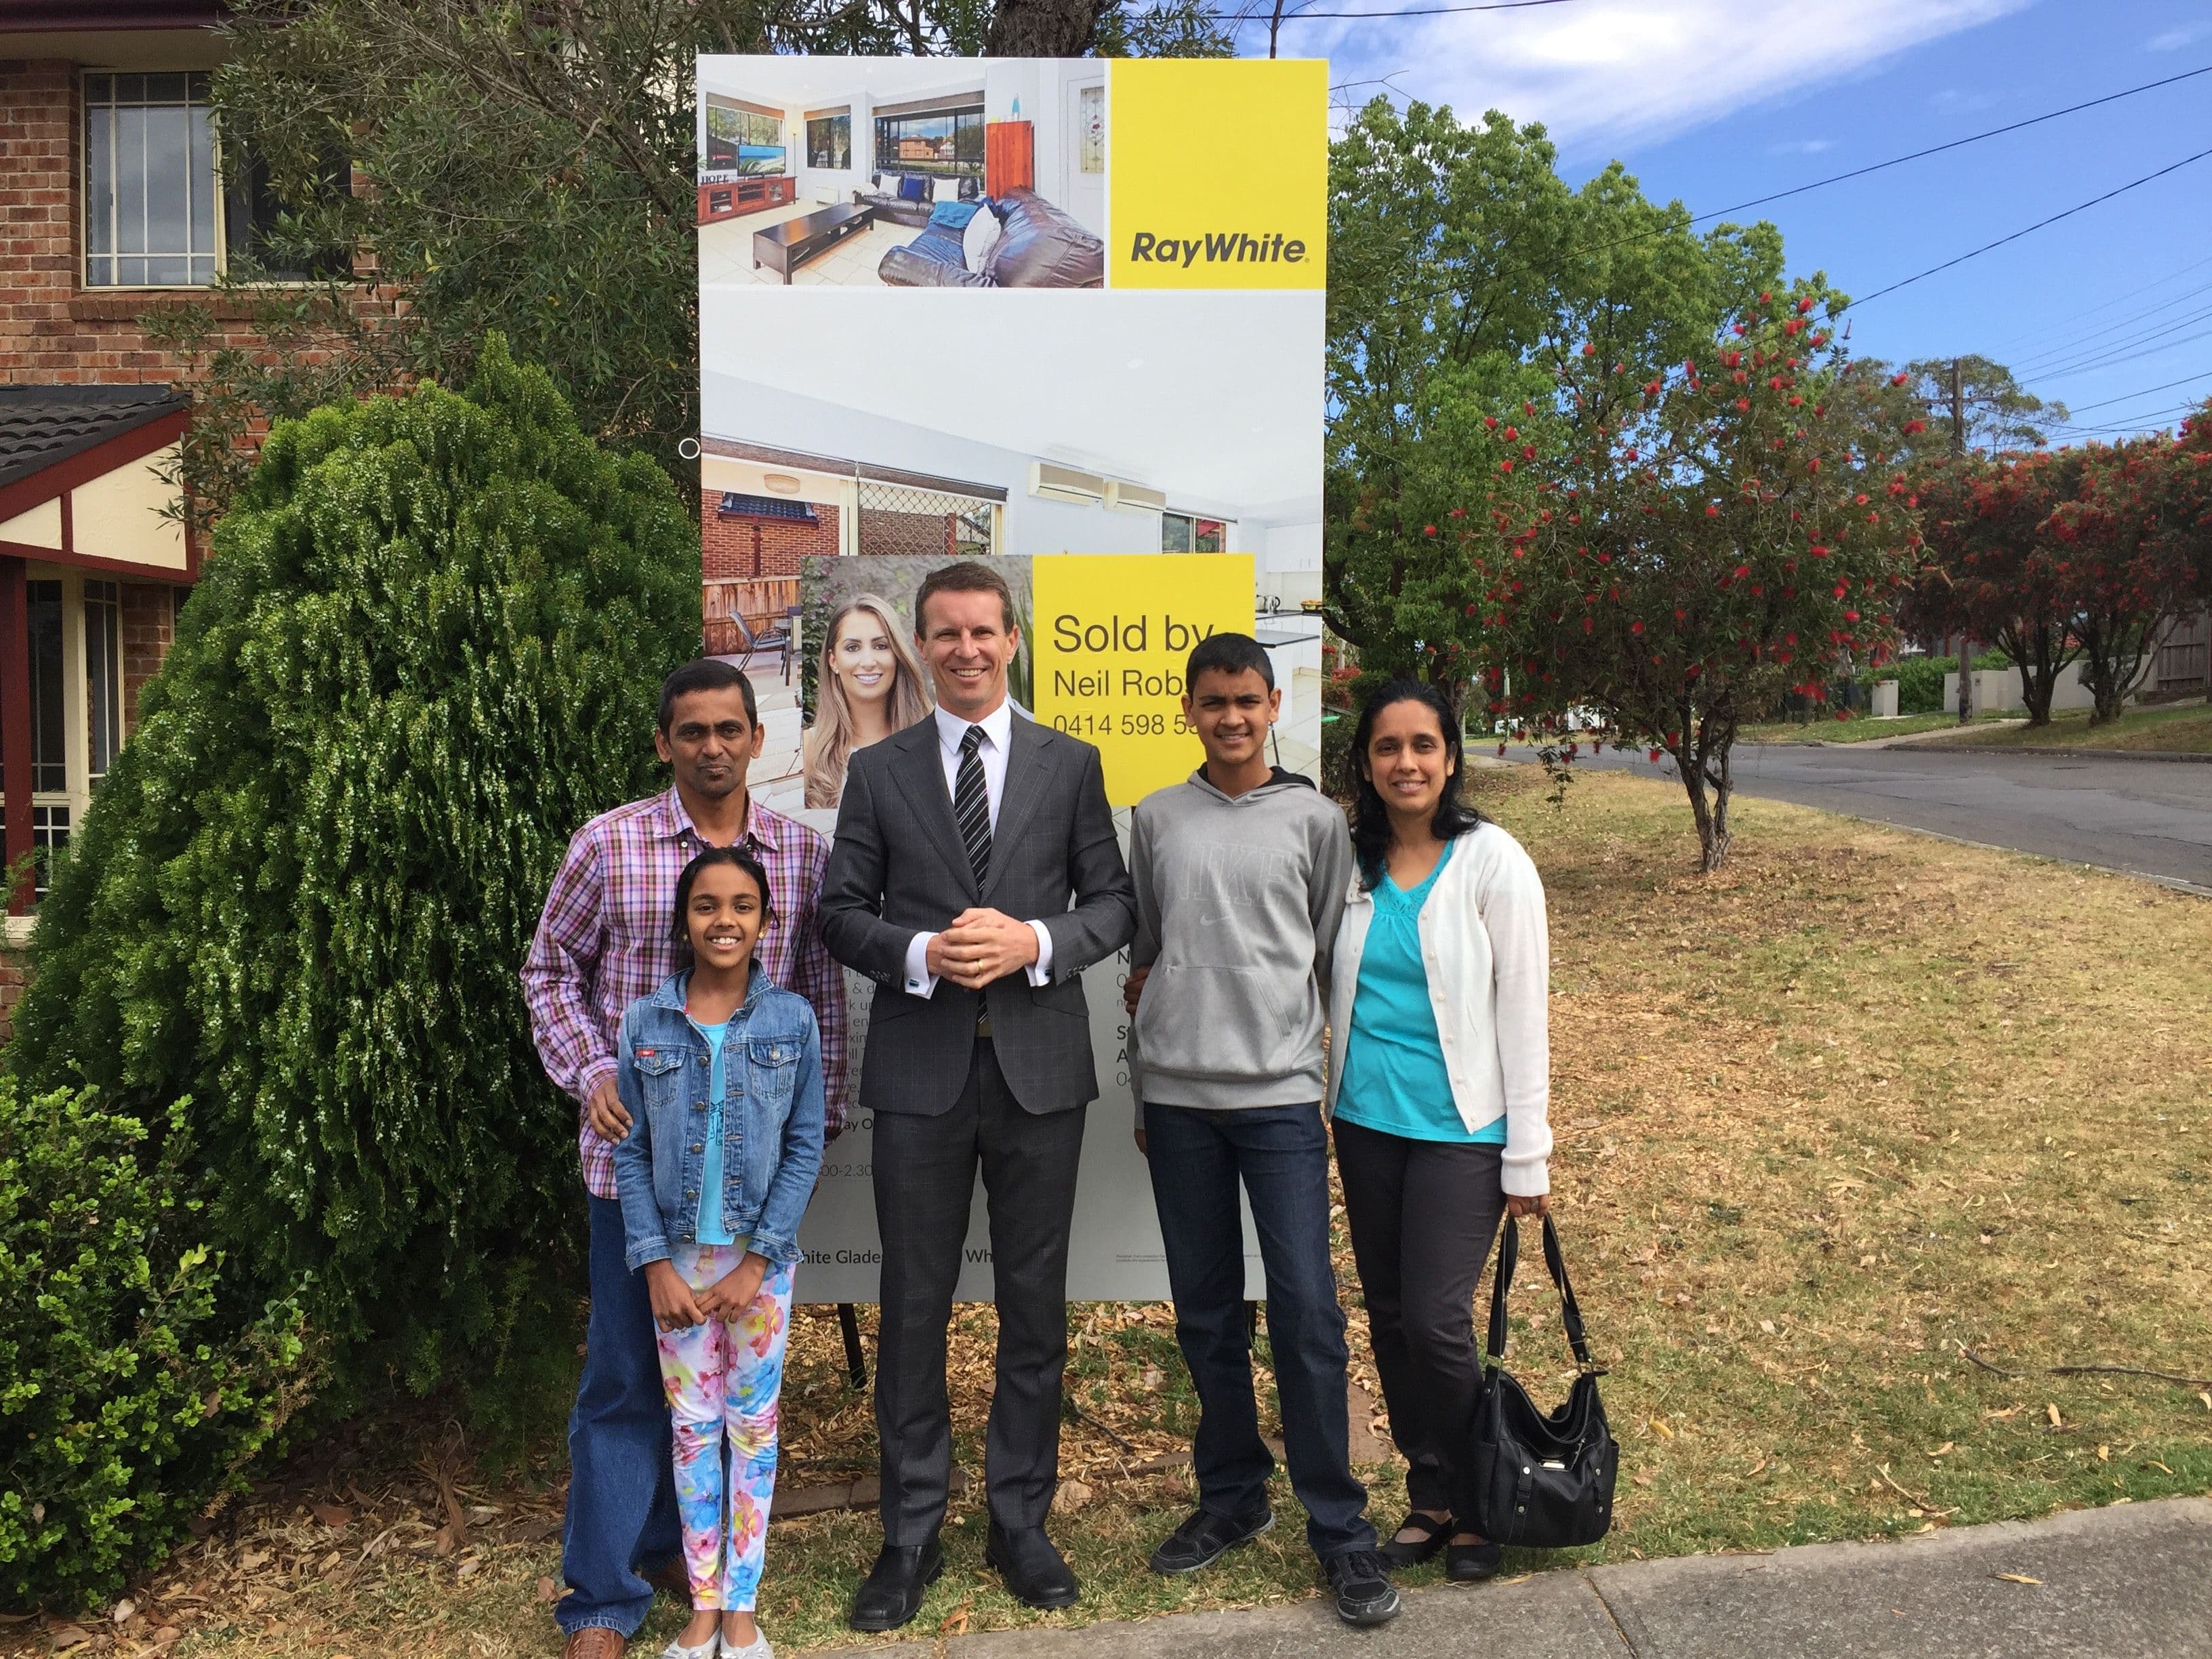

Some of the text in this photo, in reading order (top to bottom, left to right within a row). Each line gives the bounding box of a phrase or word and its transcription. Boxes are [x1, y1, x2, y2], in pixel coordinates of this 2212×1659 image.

[1053, 615, 1147, 653] Sold
[1054, 670, 1187, 697] Neil Rob
[1053, 714, 1112, 735] 0414
[1121, 714, 1165, 735] 598
[800, 1250, 831, 1264] hite
